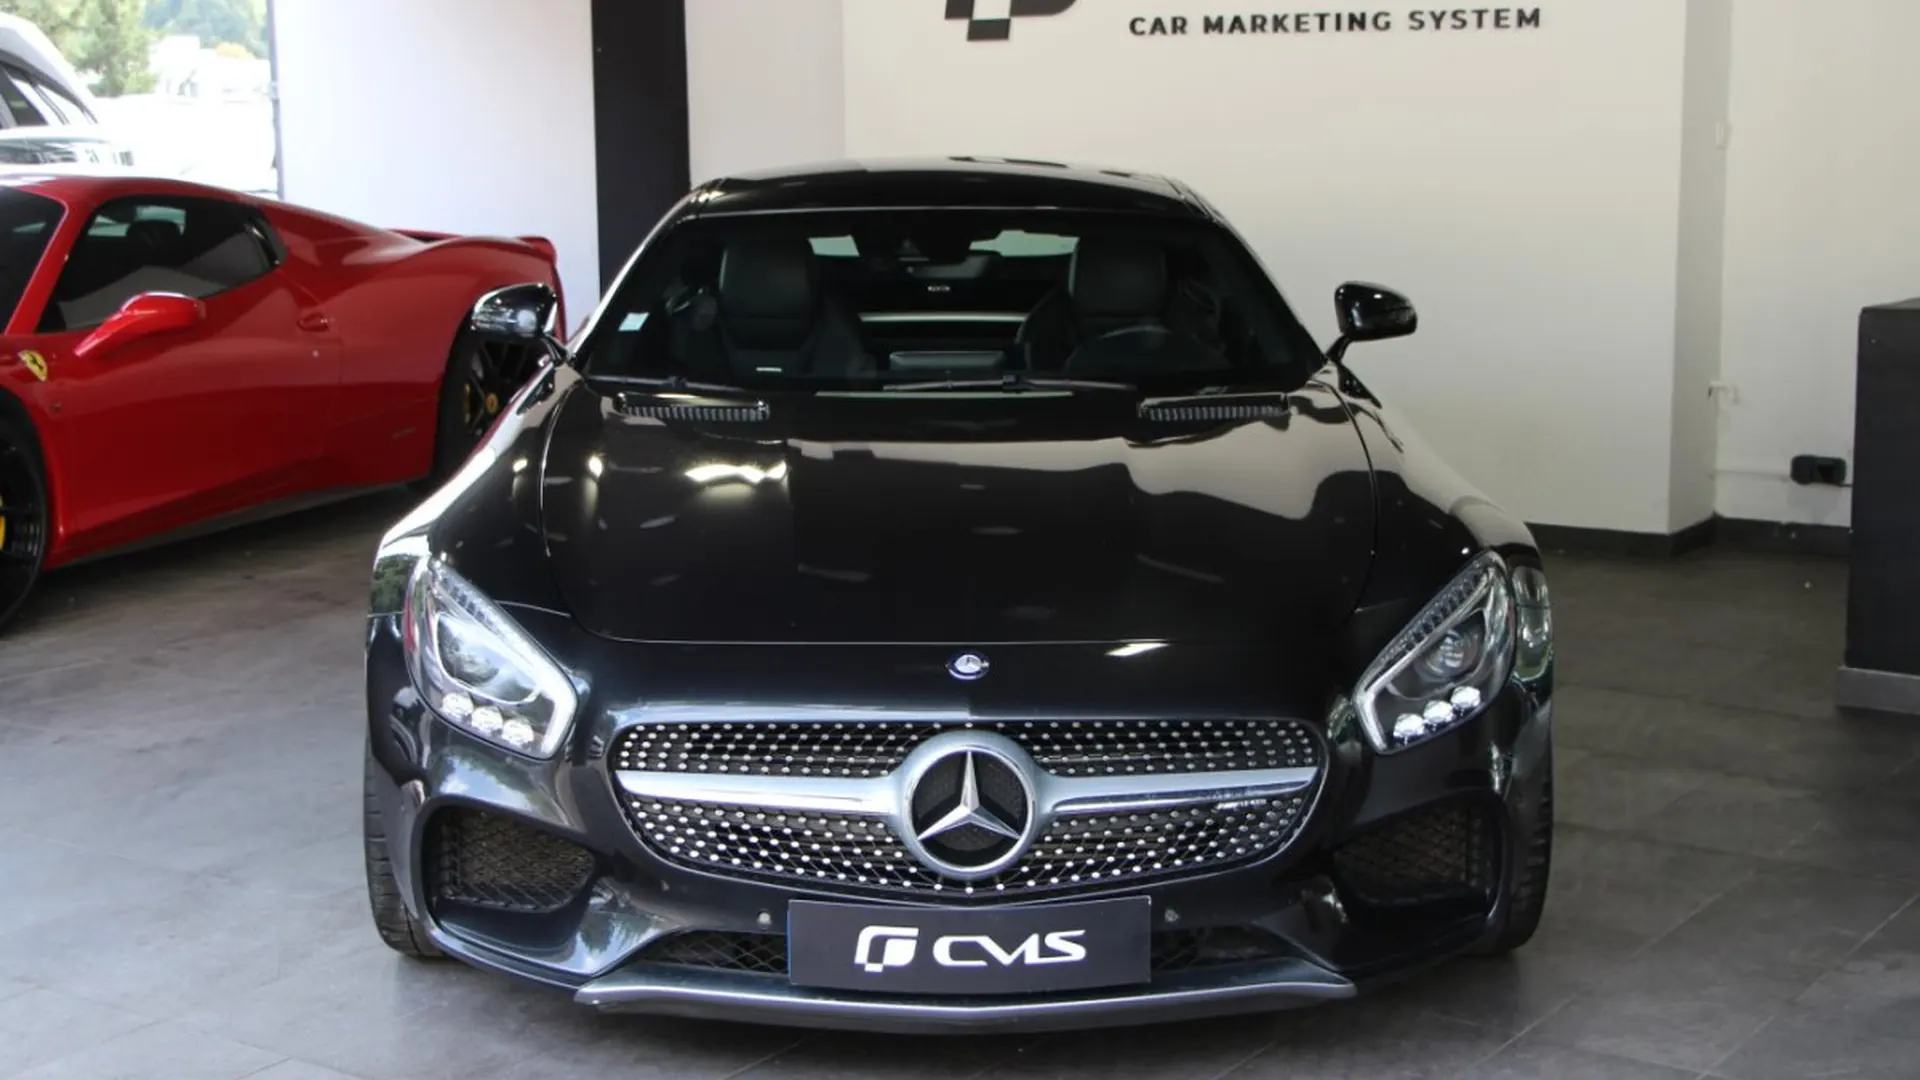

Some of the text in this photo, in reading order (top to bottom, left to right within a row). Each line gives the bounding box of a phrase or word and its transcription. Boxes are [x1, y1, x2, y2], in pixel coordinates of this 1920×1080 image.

[1129, 7, 1541, 37] CAR MARKETING SYSTEM
[932, 929, 1087, 967] CMS
